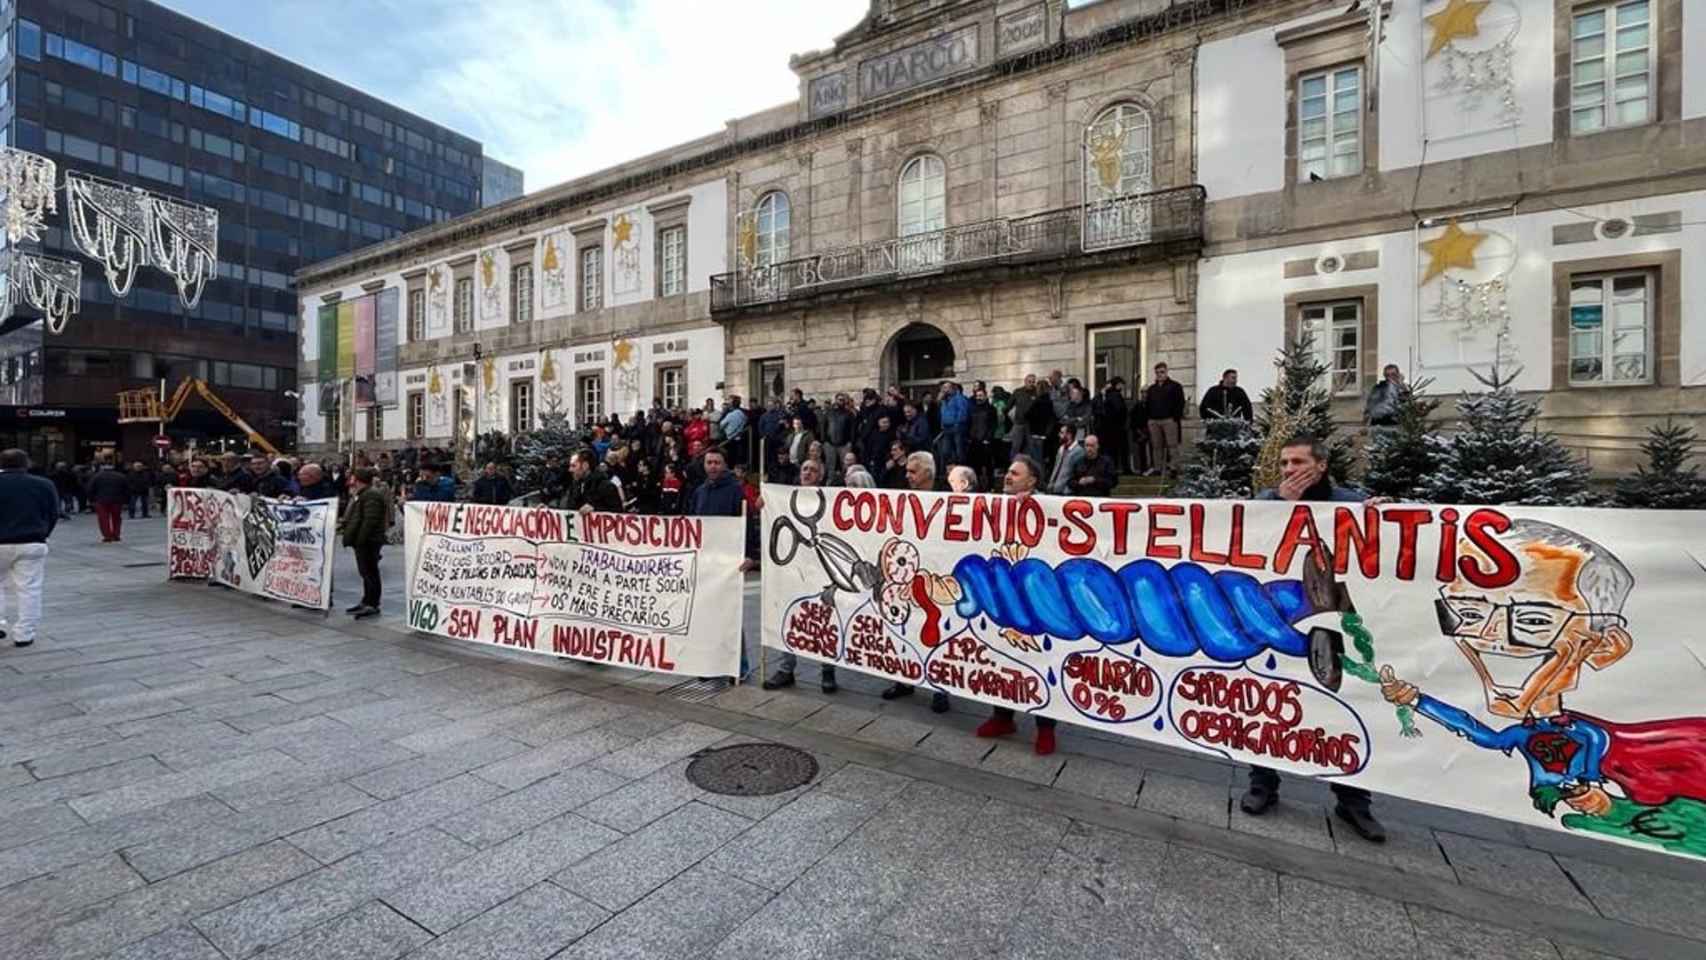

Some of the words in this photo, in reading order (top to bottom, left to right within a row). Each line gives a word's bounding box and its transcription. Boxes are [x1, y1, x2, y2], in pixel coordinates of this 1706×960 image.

[869, 38, 967, 92] MARCO
[423, 503, 450, 532] NON
[572, 560, 597, 580] PARA
[602, 573, 611, 585] A
[615, 575, 651, 593] PARTE
[655, 577, 690, 594] SOCIAL
[577, 582, 601, 600] ERE
[604, 590, 612, 604] E
[550, 592, 568, 610] OS
[570, 596, 599, 617] MAIS
[601, 604, 671, 628] PRECARIOS
[852, 614, 884, 636] SEN
[493, 614, 539, 649] PLAN
[552, 624, 675, 671] INDUSTRIAL
[846, 647, 863, 667] DE
[851, 632, 898, 656] CARGA
[928, 660, 966, 689] SEN
